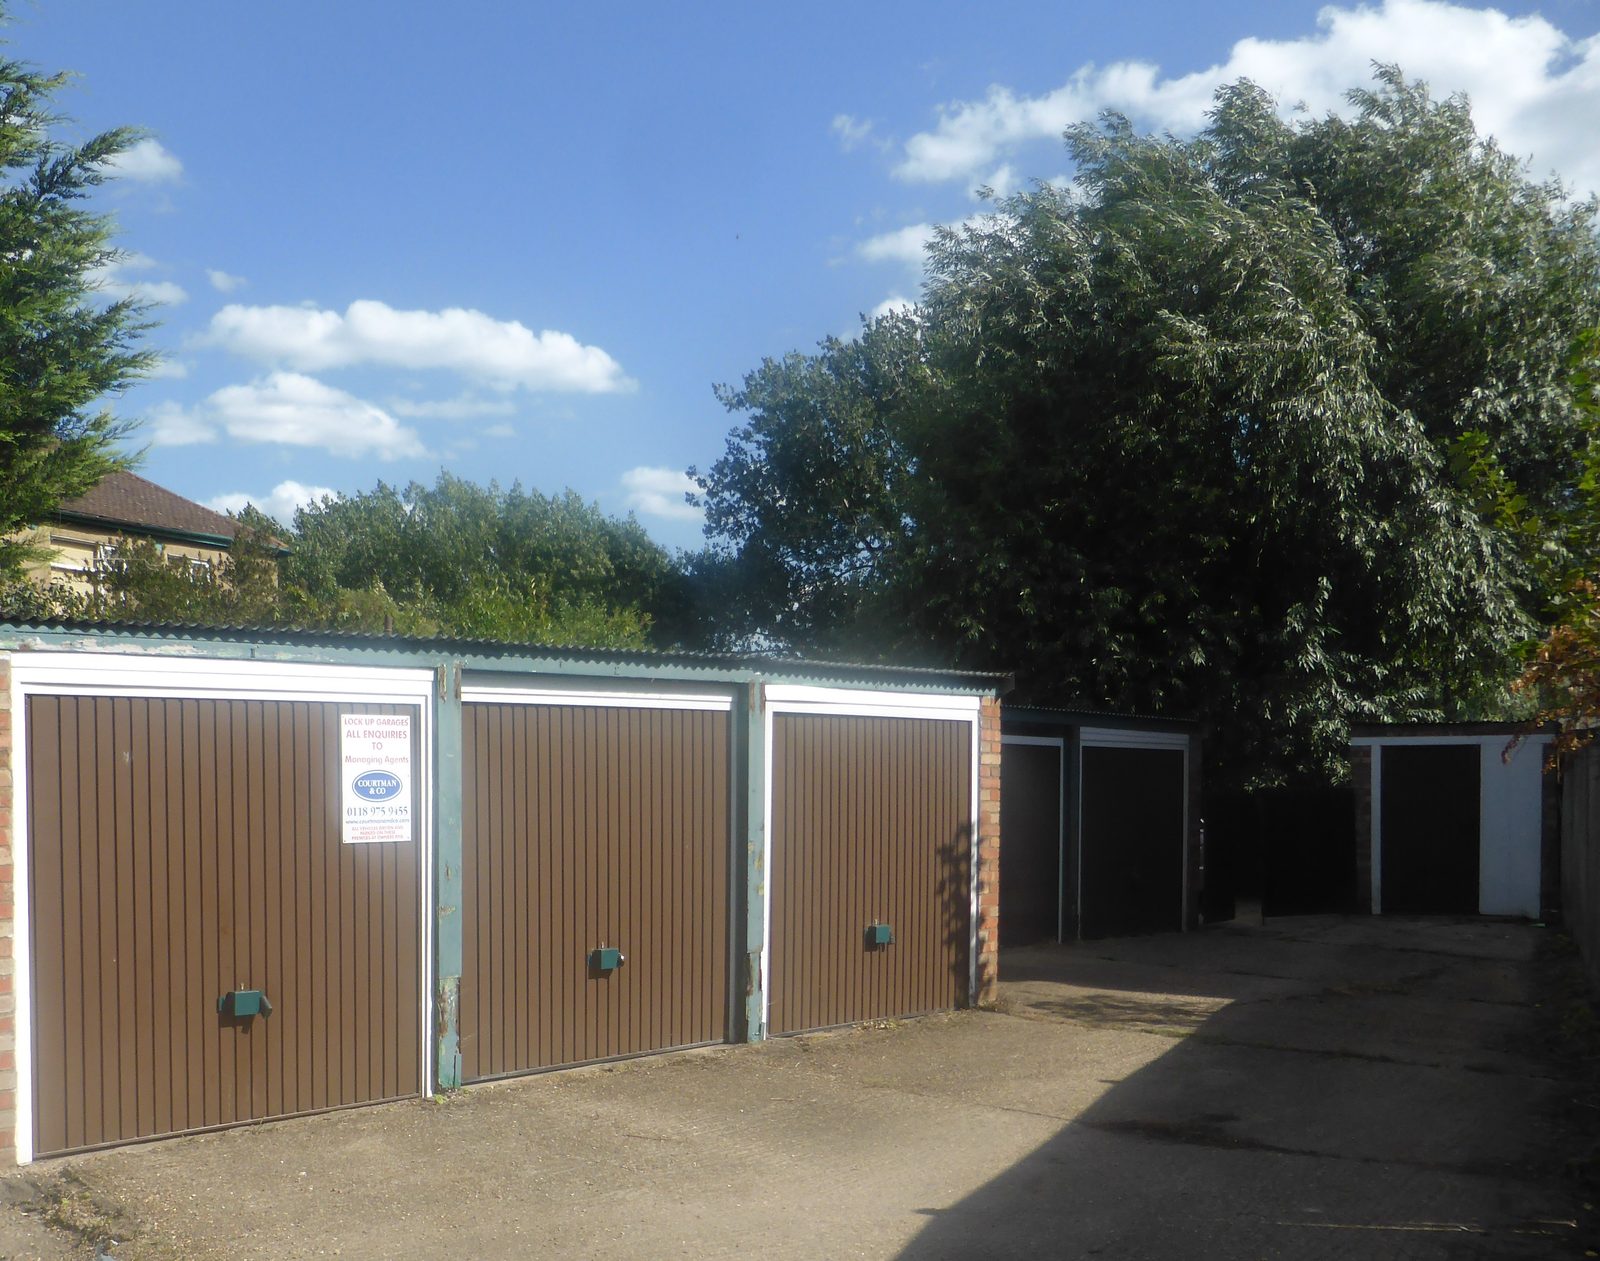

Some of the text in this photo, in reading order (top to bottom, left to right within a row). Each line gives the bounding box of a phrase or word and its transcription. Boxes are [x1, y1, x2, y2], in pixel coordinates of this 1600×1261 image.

[376, 718, 408, 726] GARAGES
[346, 730, 407, 739] ALL ENQUIRIES
[372, 742, 383, 750] TO
[345, 755, 408, 766] Managing Agents
[347, 806, 368, 816] 0118
